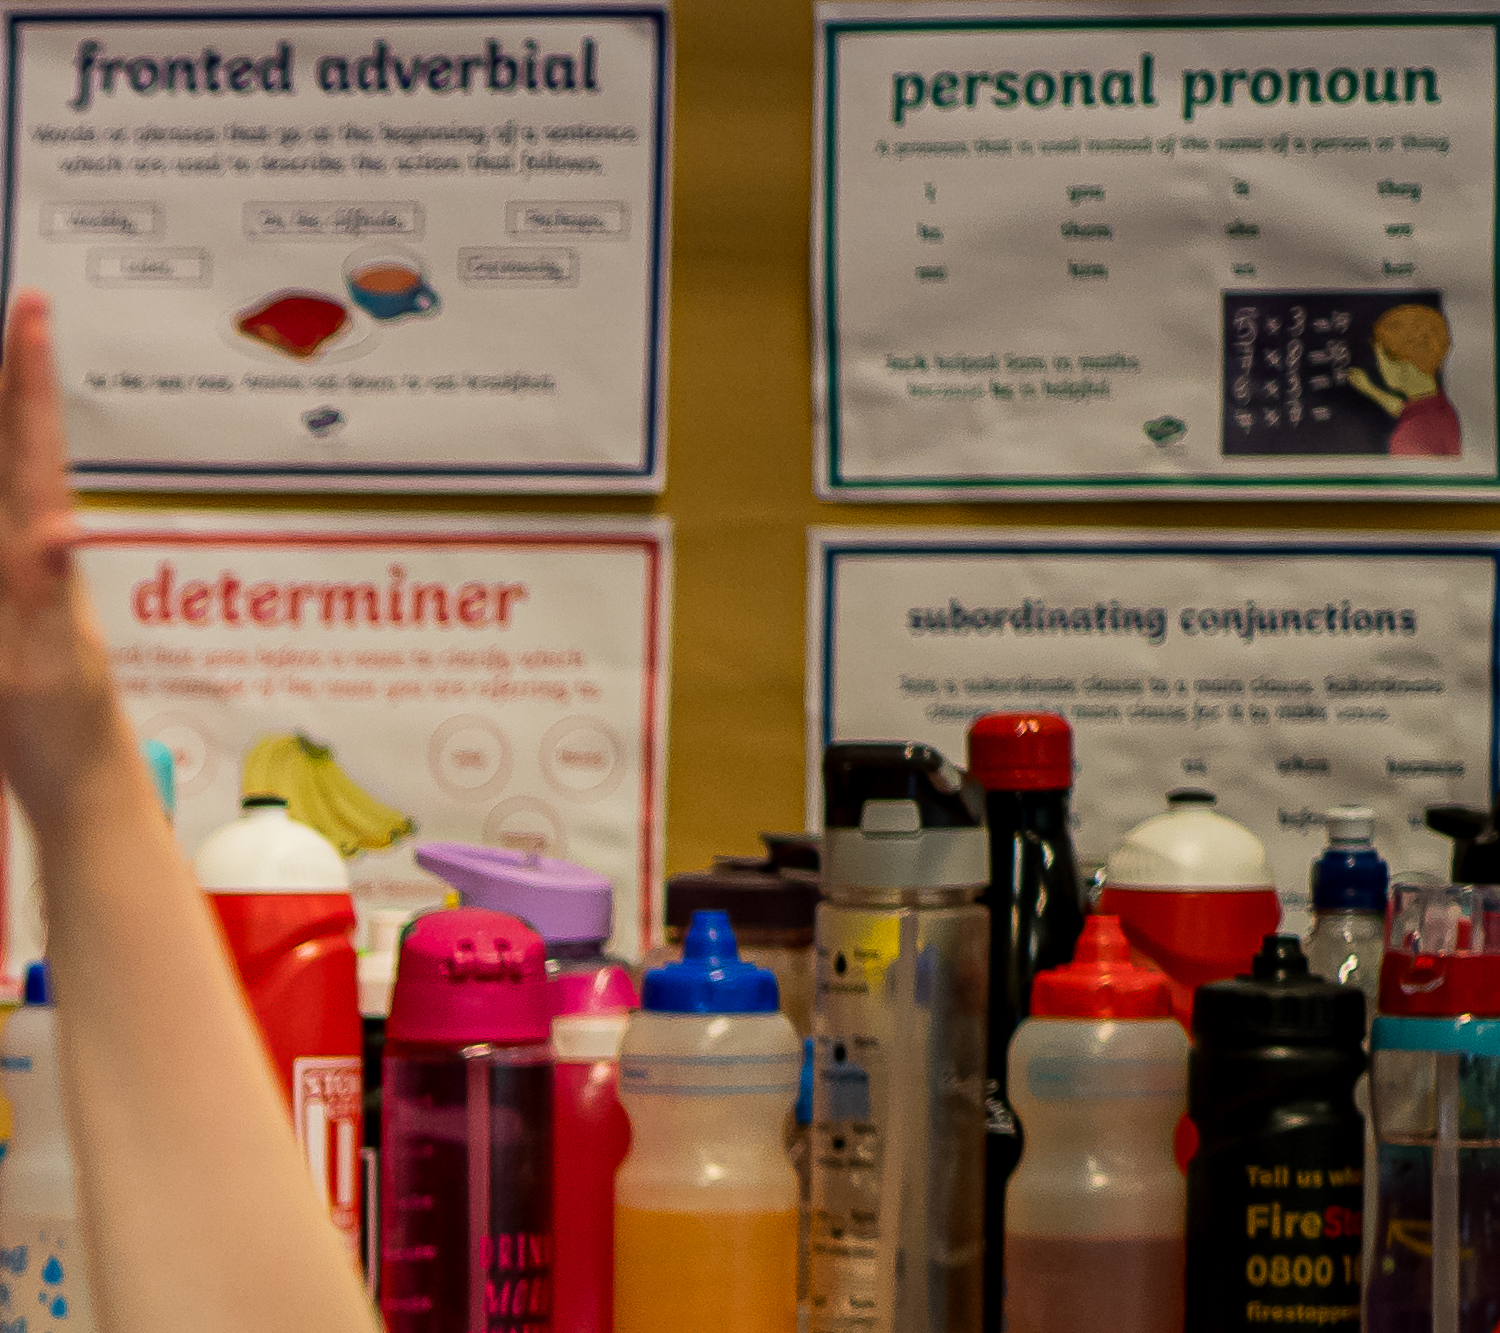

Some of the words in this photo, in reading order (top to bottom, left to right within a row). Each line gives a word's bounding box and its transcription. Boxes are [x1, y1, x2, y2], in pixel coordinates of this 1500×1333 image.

[70, 41, 293, 109] fronted
[317, 37, 599, 95] adverbial
[893, 53, 1156, 125] personal
[1182, 65, 1441, 121] pronoun
[132, 559, 530, 626] determiner
[906, 599, 1169, 644] subordinating
[1177, 601, 1417, 642] conjunctions
[1247, 1166, 1289, 1187] Tell
[1297, 1171, 1323, 1188] us
[1247, 1255, 1334, 1287] 0800
